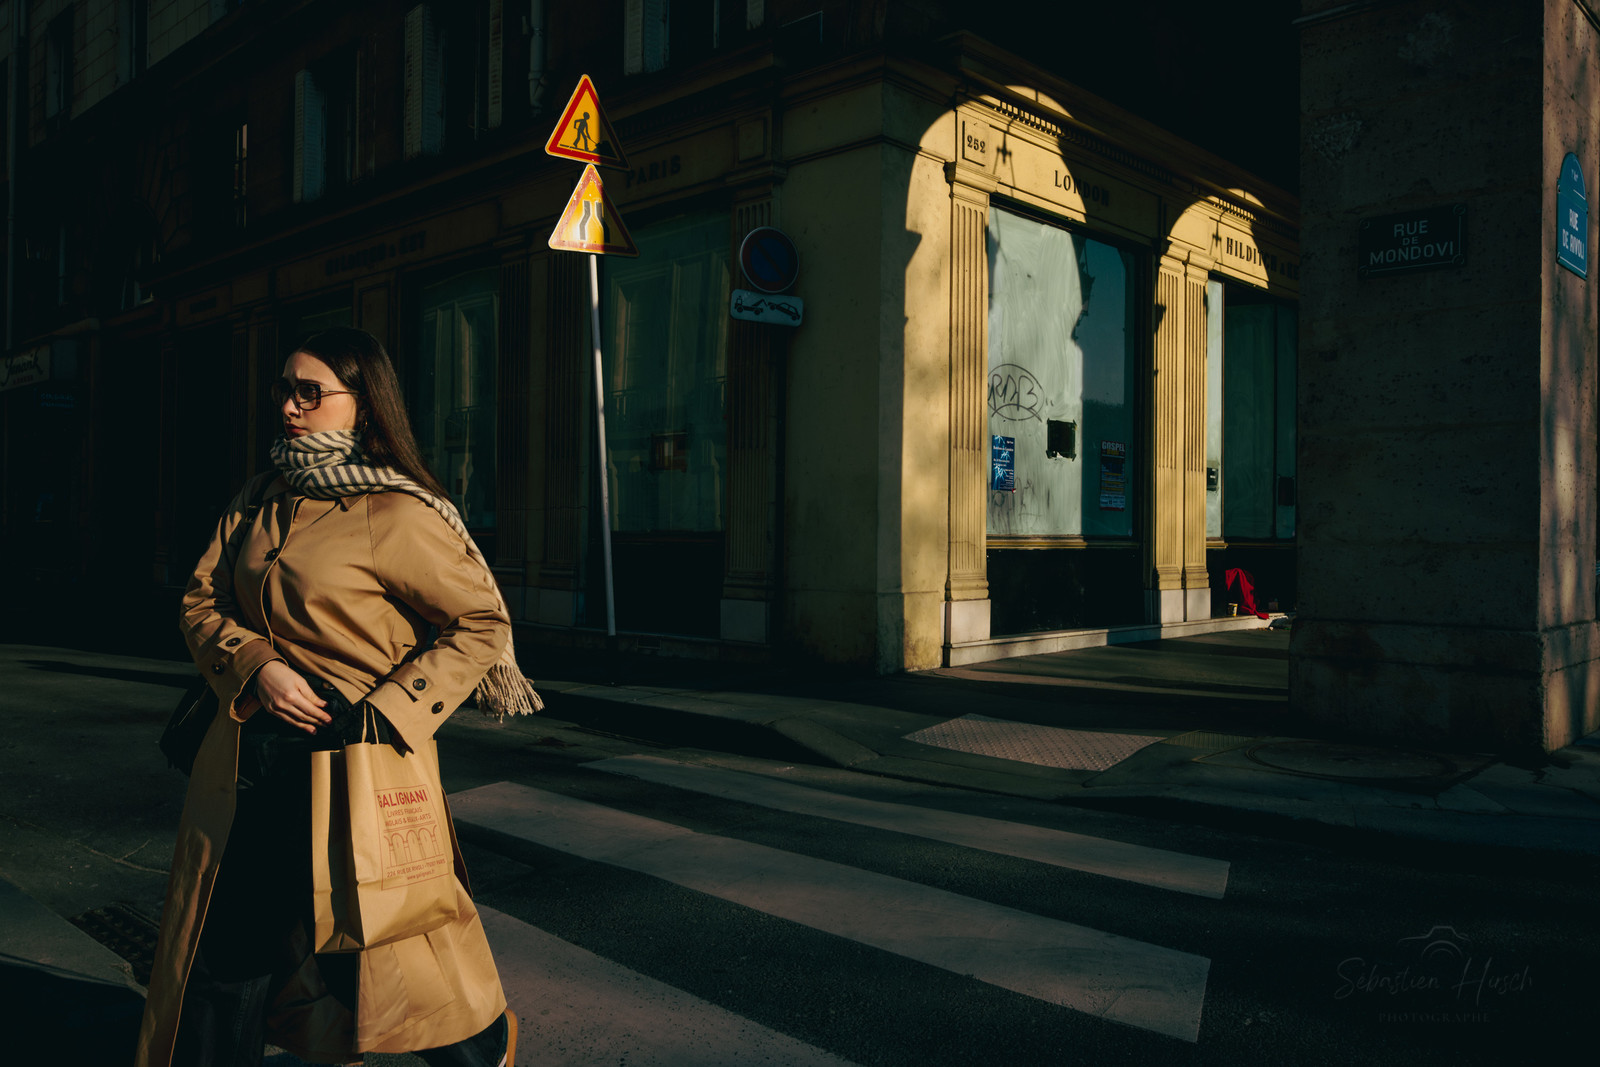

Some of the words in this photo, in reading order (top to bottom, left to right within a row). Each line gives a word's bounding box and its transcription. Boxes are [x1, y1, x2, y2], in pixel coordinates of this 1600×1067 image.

[966, 134, 986, 155] 252
[625, 154, 681, 189] PARIS
[1054, 169, 1111, 207] LONDON
[1393, 219, 1429, 238] RUE
[1569, 208, 1579, 231] RUE
[1402, 236, 1419, 246] DE
[1562, 228, 1569, 250] DE
[1369, 241, 1454, 265] MONDOVI
[1101, 441, 1125, 452] GOSPEL
[377, 789, 428, 808] GALIGNANI
